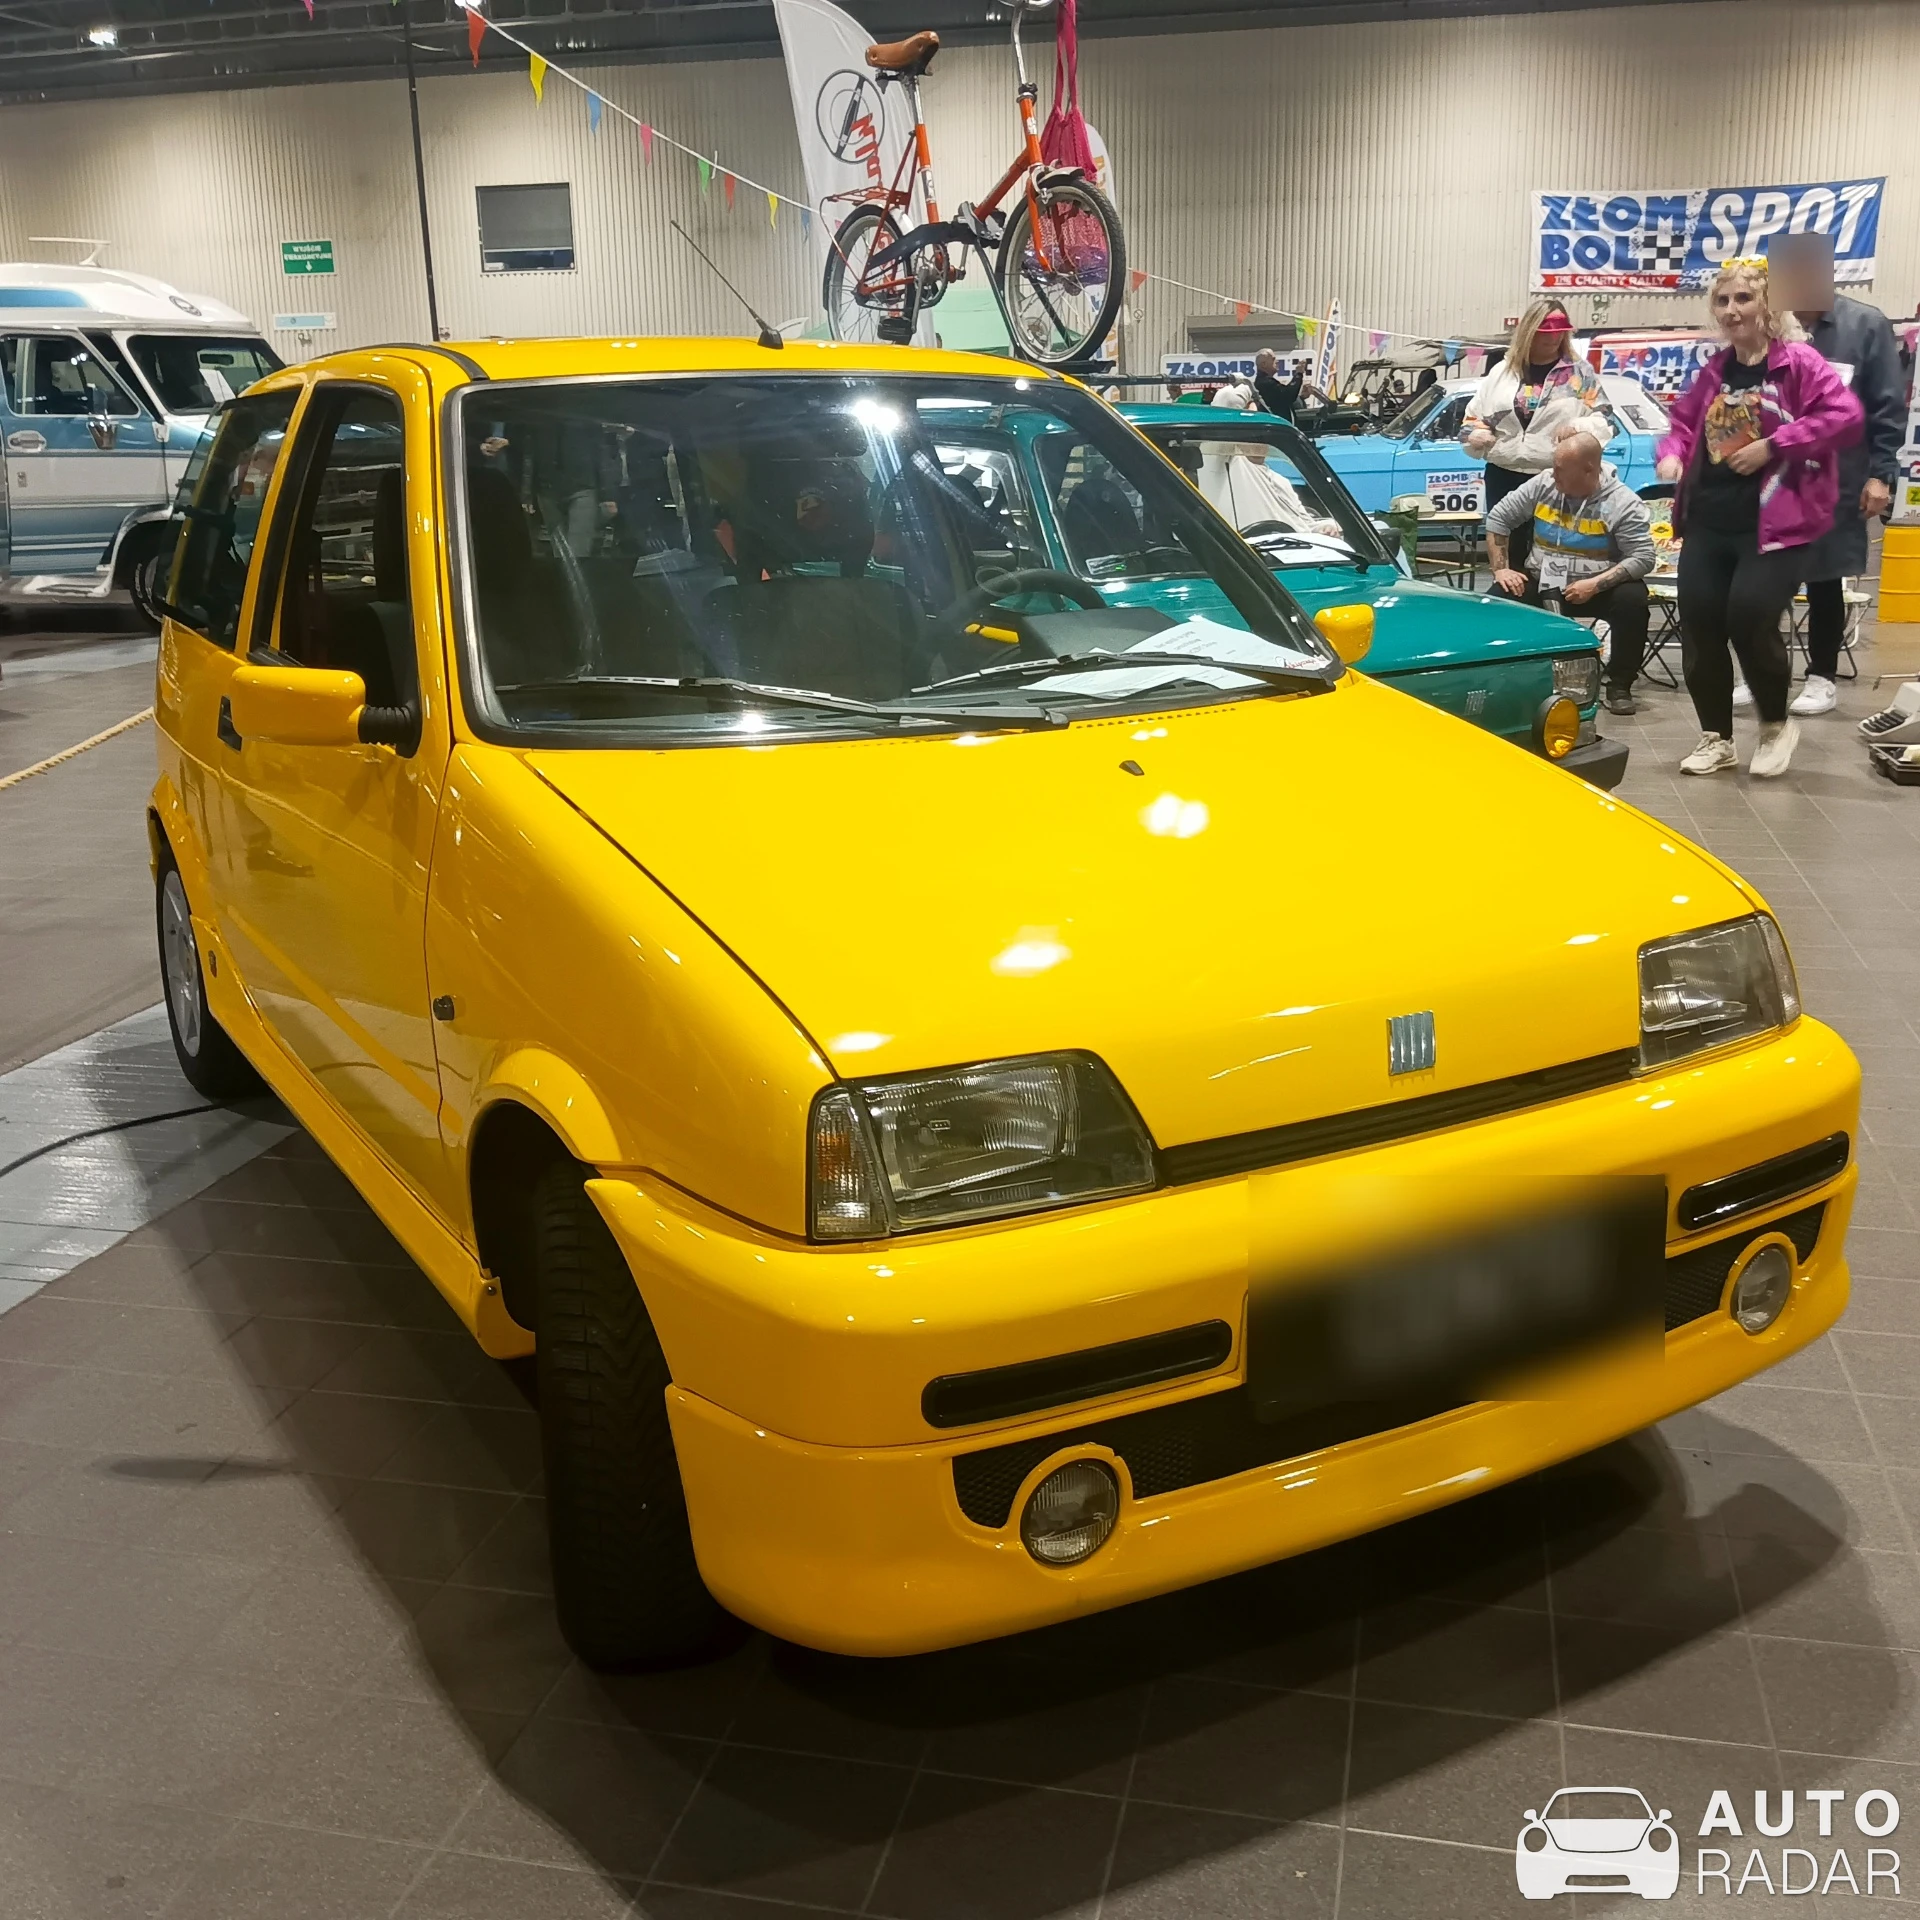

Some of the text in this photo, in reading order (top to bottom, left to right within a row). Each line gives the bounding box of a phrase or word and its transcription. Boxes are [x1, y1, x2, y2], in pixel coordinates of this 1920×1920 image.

[1540, 195, 1687, 231] ZŁOM
[1540, 234, 1643, 270] BOL
[1554, 275, 1666, 287] THE CHARITY RALLY
[1166, 359, 1290, 377] ZŁOMBL
[1432, 493, 1478, 512] 506
